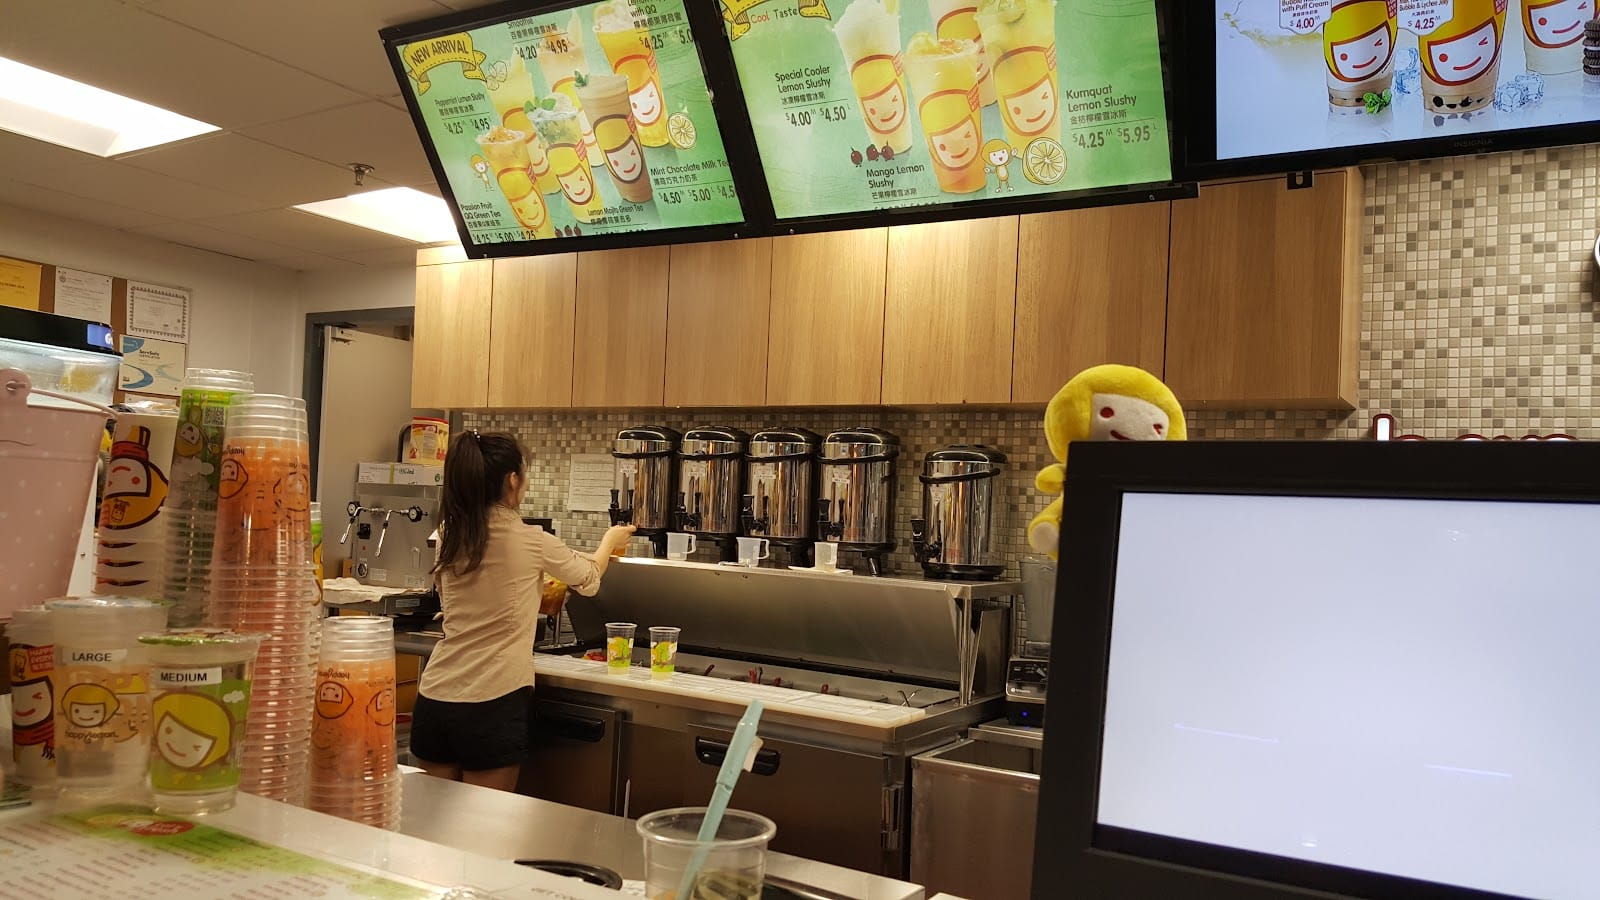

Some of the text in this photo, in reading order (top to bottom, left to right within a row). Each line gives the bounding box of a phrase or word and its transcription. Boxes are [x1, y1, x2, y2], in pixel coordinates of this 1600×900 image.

[630, 4, 657, 18] with QQ
[751, 8, 798, 23] Cool Taste
[410, 39, 469, 67] NEW ARRIVAL
[775, 66, 830, 83] Special Cooler
[777, 77, 831, 93] Lemon Slushy
[1066, 84, 1112, 100] Kumquat
[1068, 94, 1137, 113] Lemon Slushy
[650, 167, 665, 176] Mint
[666, 163, 700, 174] Chocolate
[702, 160, 716, 170] Milk
[867, 165, 925, 178] Mango Lemon
[868, 178, 894, 189] Slushy
[461, 203, 480, 211] Passion
[474, 211, 490, 219] Green
[490, 210, 501, 218] Tea
[72, 652, 112, 662] LARGE
[160, 672, 208, 682] MEDIUM
